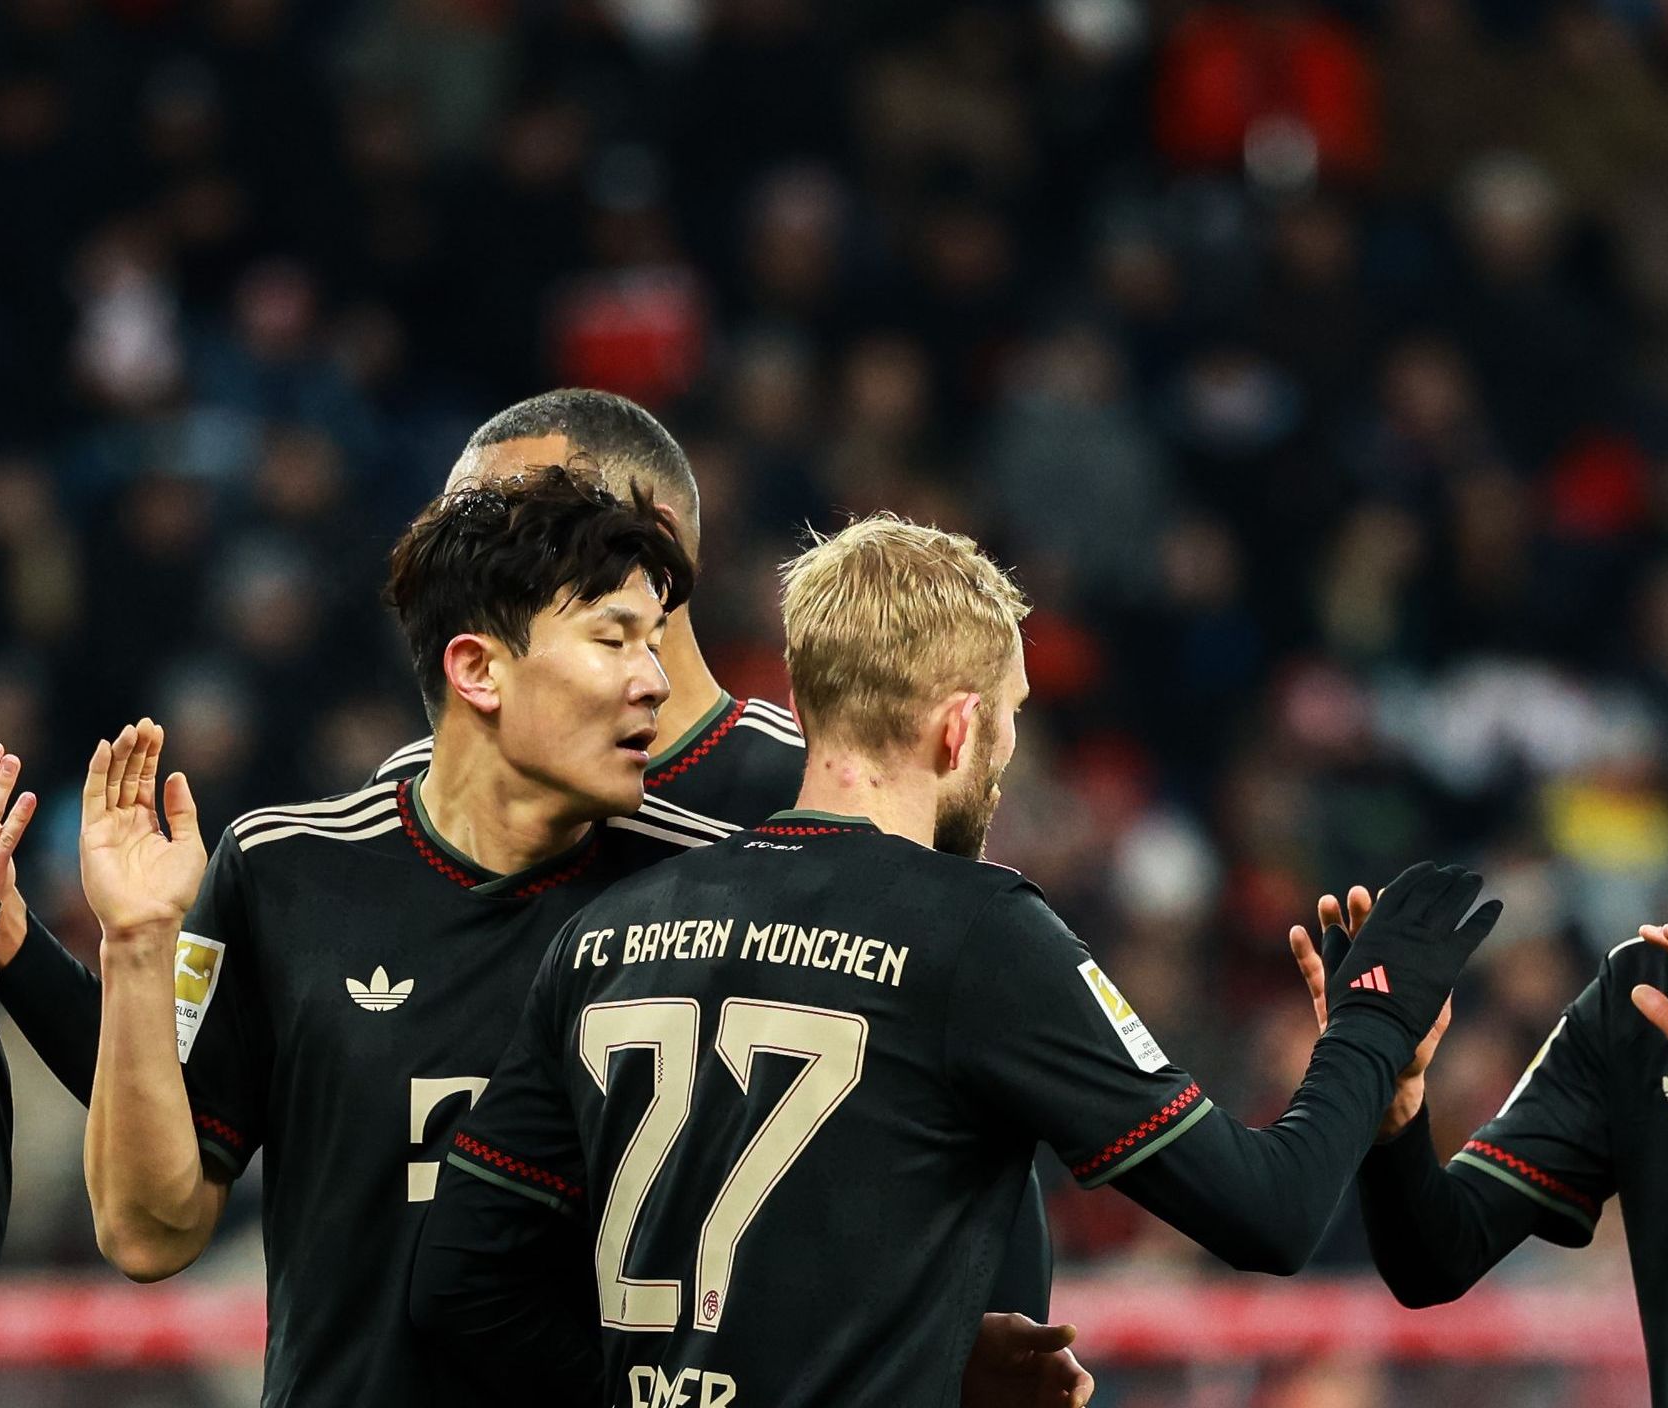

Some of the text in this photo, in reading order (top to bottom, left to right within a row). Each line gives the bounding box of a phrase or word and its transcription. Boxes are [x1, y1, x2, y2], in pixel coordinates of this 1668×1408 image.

[573, 928, 615, 969] FC
[623, 919, 734, 965] BAYERN
[579, 997, 870, 1333] 27
